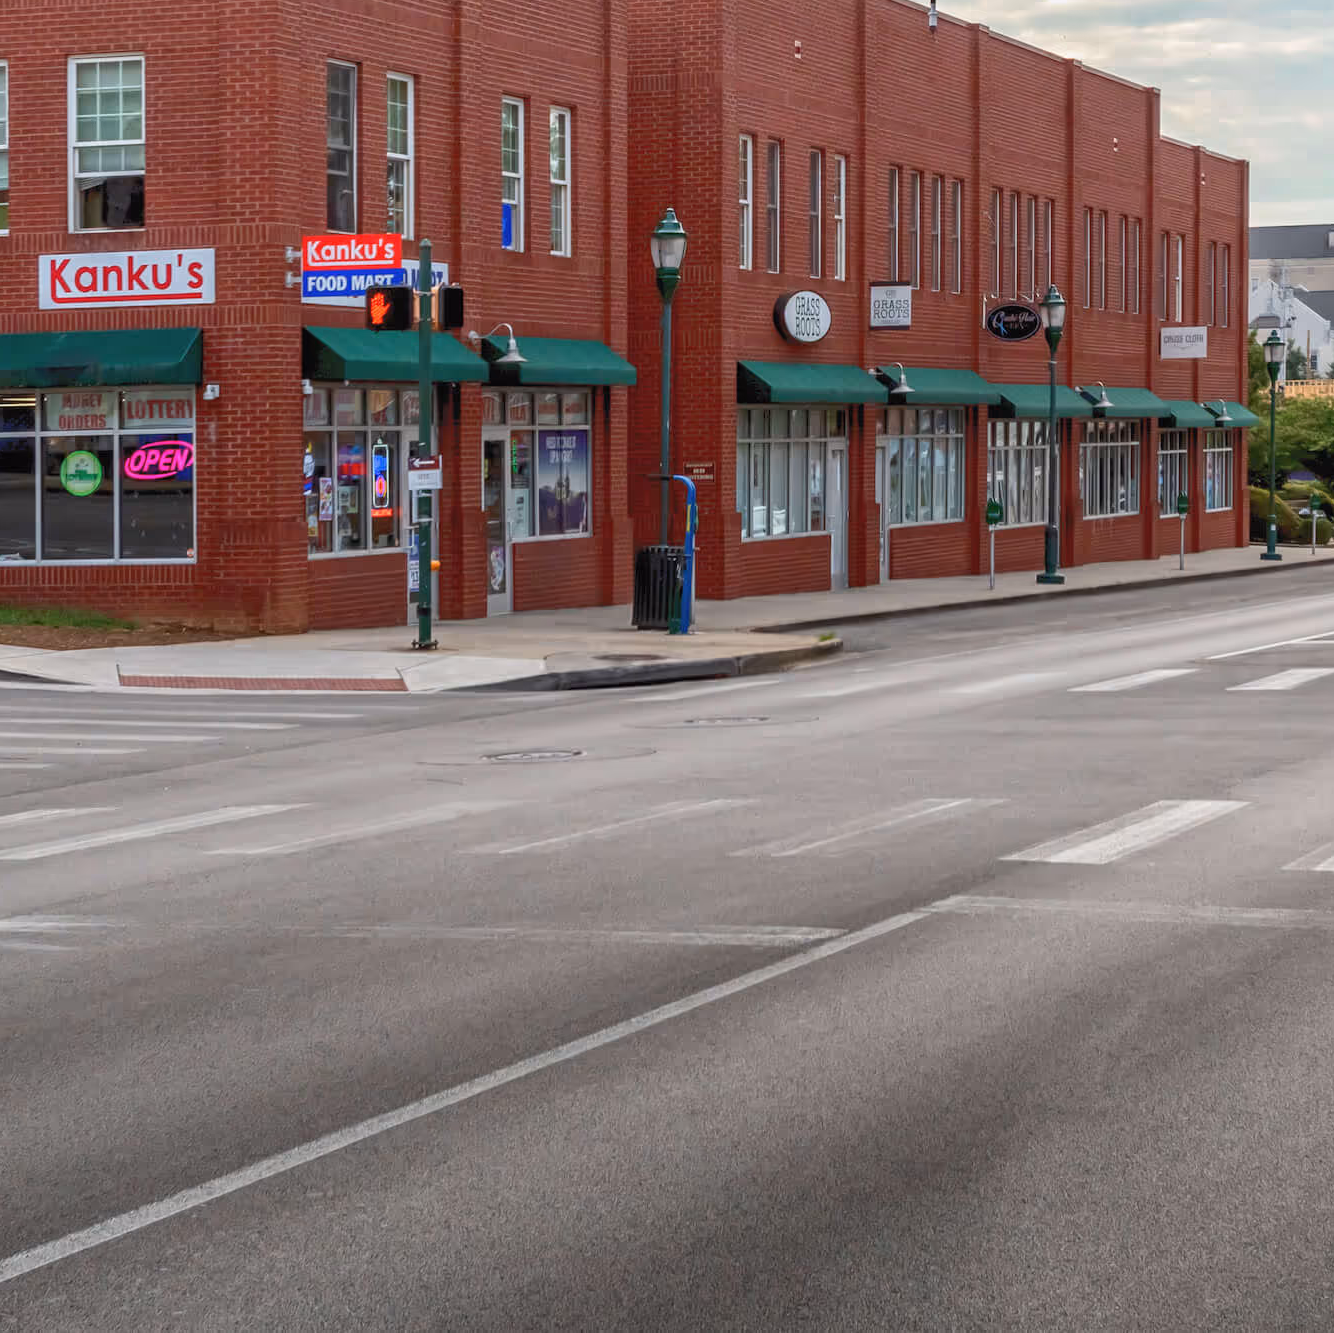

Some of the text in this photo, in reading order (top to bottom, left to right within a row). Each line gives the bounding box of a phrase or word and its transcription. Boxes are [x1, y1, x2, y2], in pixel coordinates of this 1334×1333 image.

[307, 238, 395, 266] Kanku's
[50, 254, 204, 303] Kanku's
[307, 275, 347, 292] FOOD
[795, 296, 820, 316] GRASS
[873, 299, 909, 309] GRASS
[873, 309, 909, 319] ROOTS
[795, 316, 820, 337] ROOTS
[58, 414, 107, 430] ORDERS
[130, 449, 189, 472] OPEN
